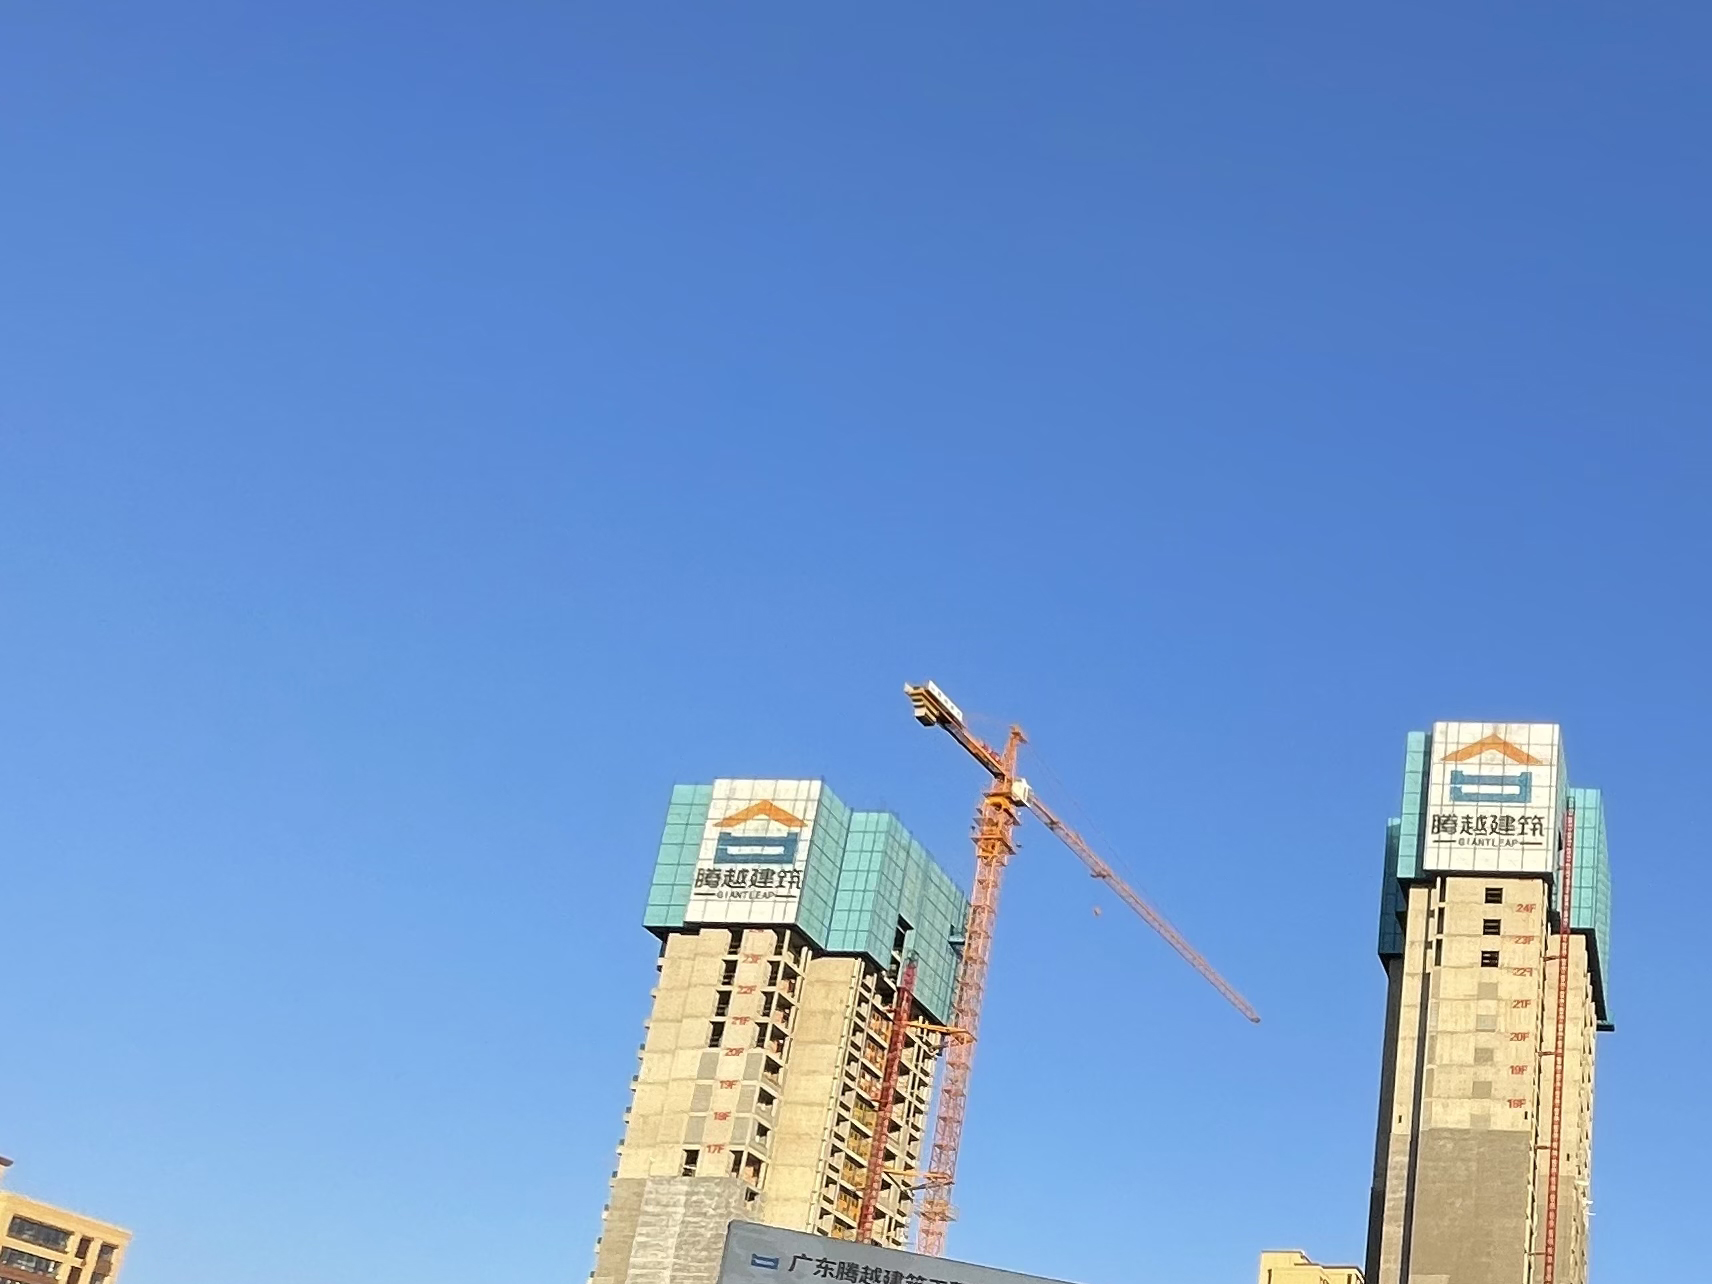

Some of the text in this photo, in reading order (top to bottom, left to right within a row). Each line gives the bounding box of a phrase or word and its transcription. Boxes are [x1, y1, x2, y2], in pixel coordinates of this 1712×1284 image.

[1431, 814, 1545, 836] 腾越建筑
[694, 867, 804, 890] 腾越建筑
[1516, 904, 1536, 914] 24F
[1510, 1032, 1530, 1042] 20F
[724, 1048, 744, 1057] 20F
[706, 1144, 726, 1154] 17F
